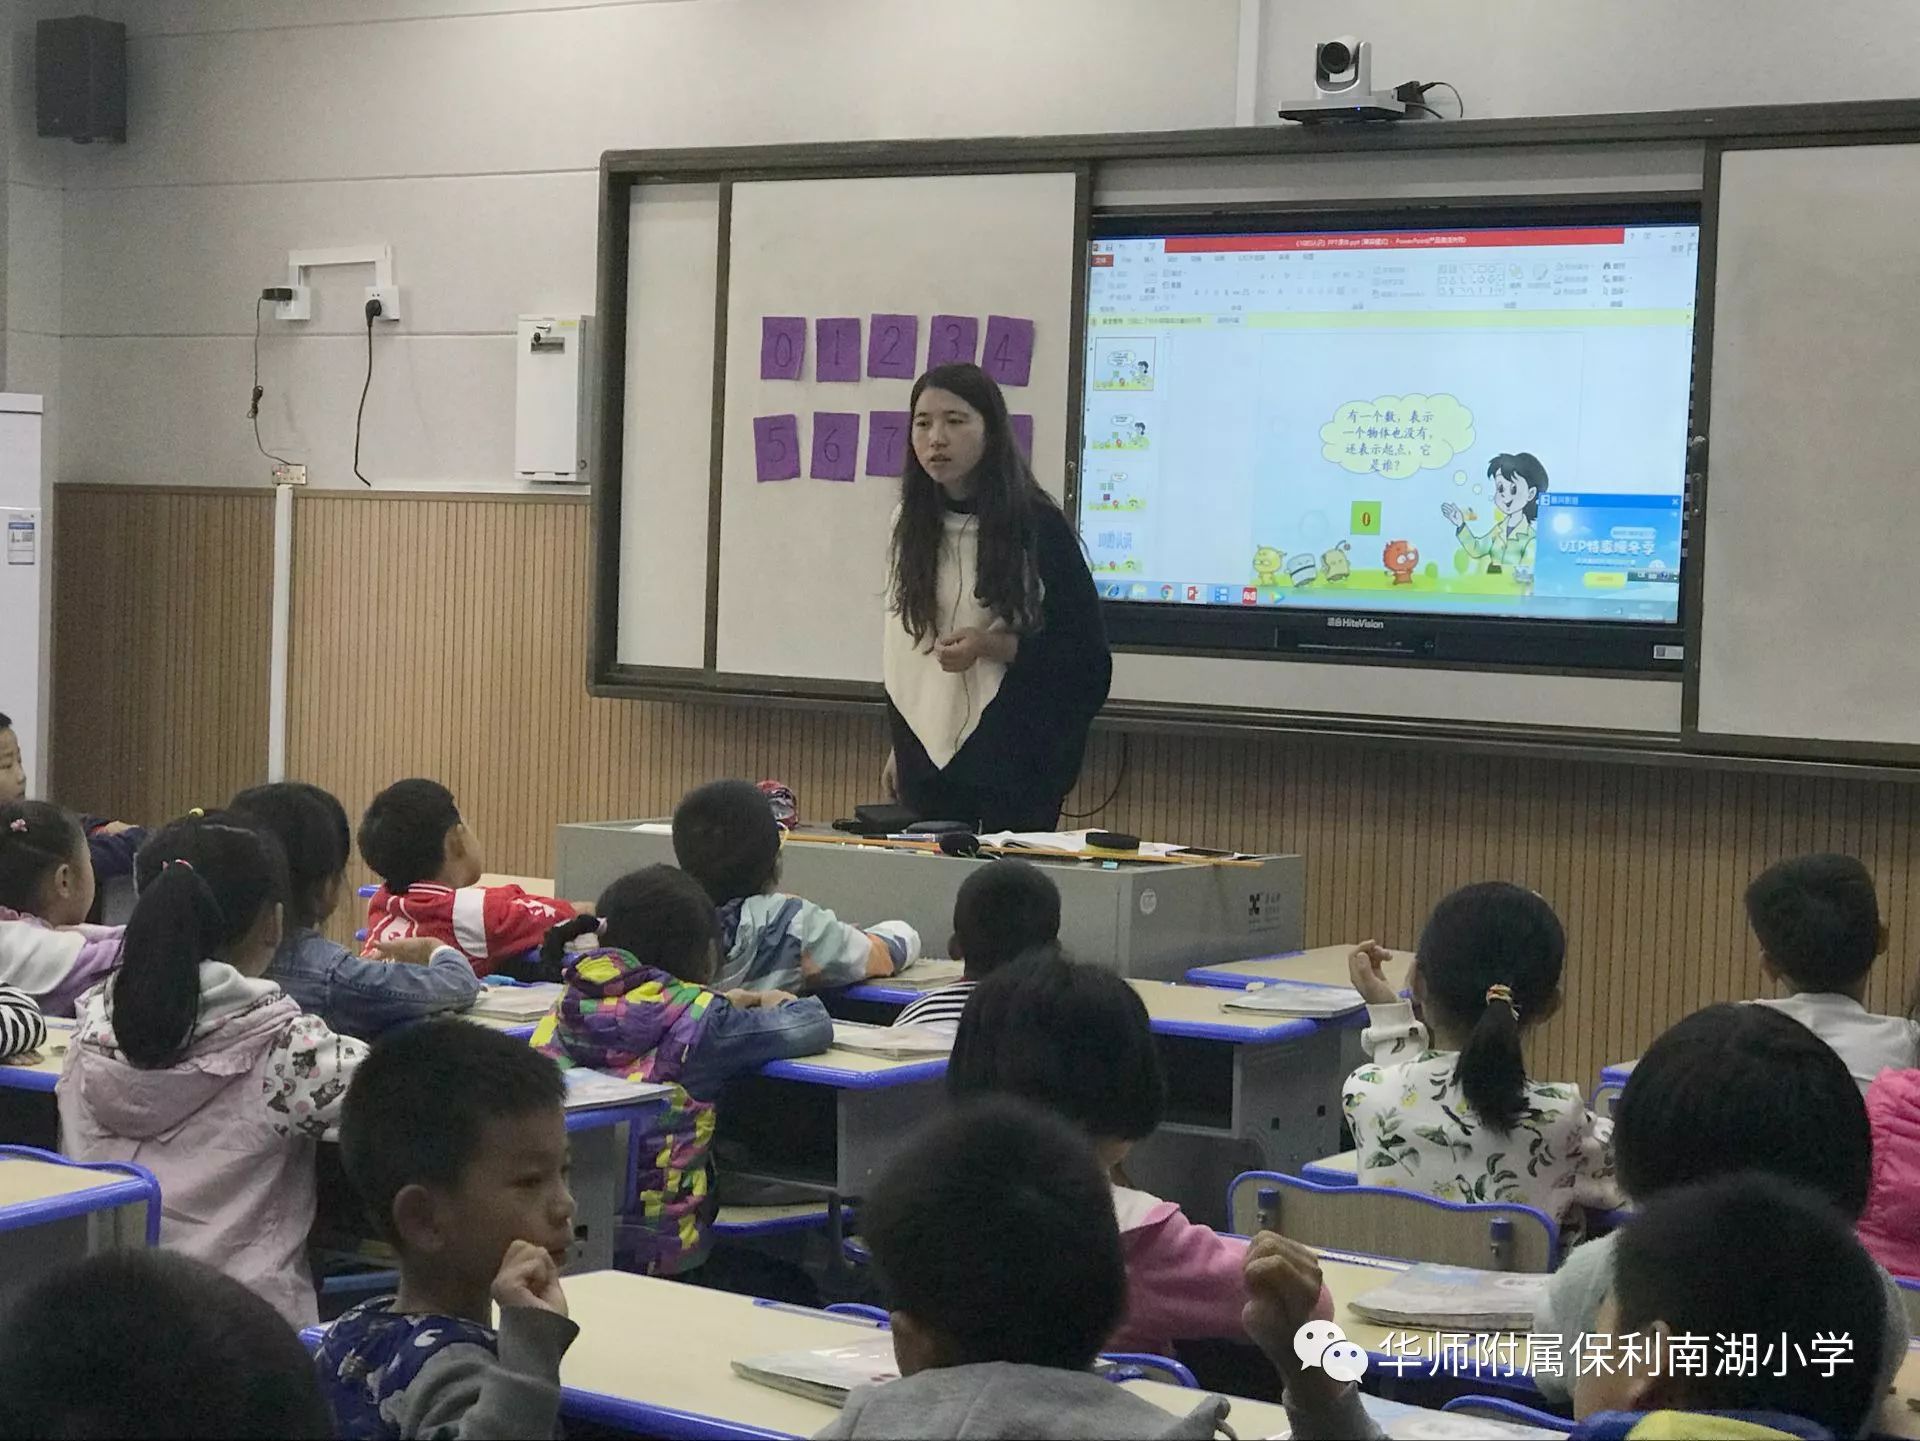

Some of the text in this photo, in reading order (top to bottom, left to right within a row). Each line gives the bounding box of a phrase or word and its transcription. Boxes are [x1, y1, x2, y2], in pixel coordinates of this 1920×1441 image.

[774, 331, 793, 368] 0
[833, 328, 842, 367] 1
[879, 325, 902, 366] 2
[993, 333, 1015, 371] 4
[767, 425, 900, 464] 5 6 7
[1362, 511, 1371, 527] 0
